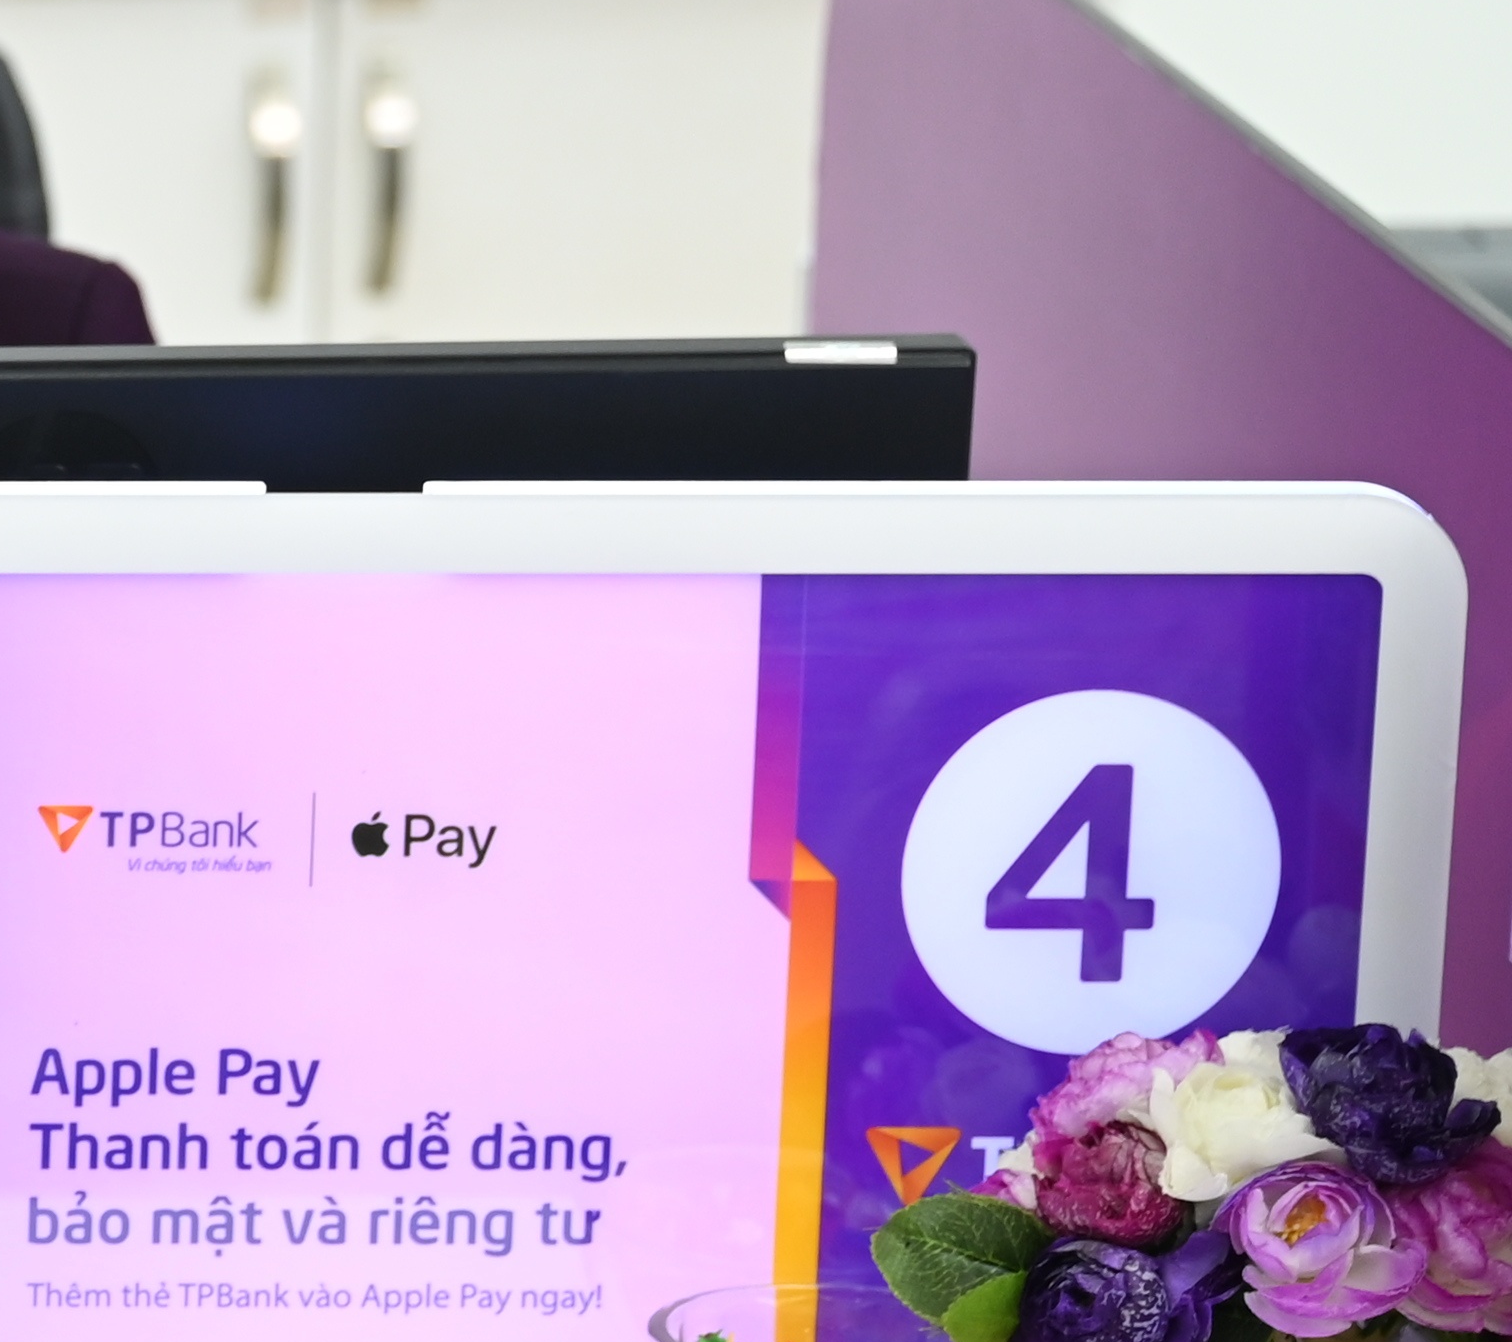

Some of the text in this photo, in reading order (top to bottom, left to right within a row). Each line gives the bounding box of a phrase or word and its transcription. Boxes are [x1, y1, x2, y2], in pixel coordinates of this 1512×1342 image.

[100, 811, 259, 848] TPBank
[403, 814, 497, 869] Pay
[984, 764, 1155, 983] 4
[30, 1048, 321, 1108] Apple Pay
[29, 1111, 628, 1183] Thanh toán dễ dàng,
[28, 1189, 602, 1259] bảo mật và riêng tư
[27, 1280, 603, 1316] Thêm thẻ TPBank vào Apple Pay ngay!
